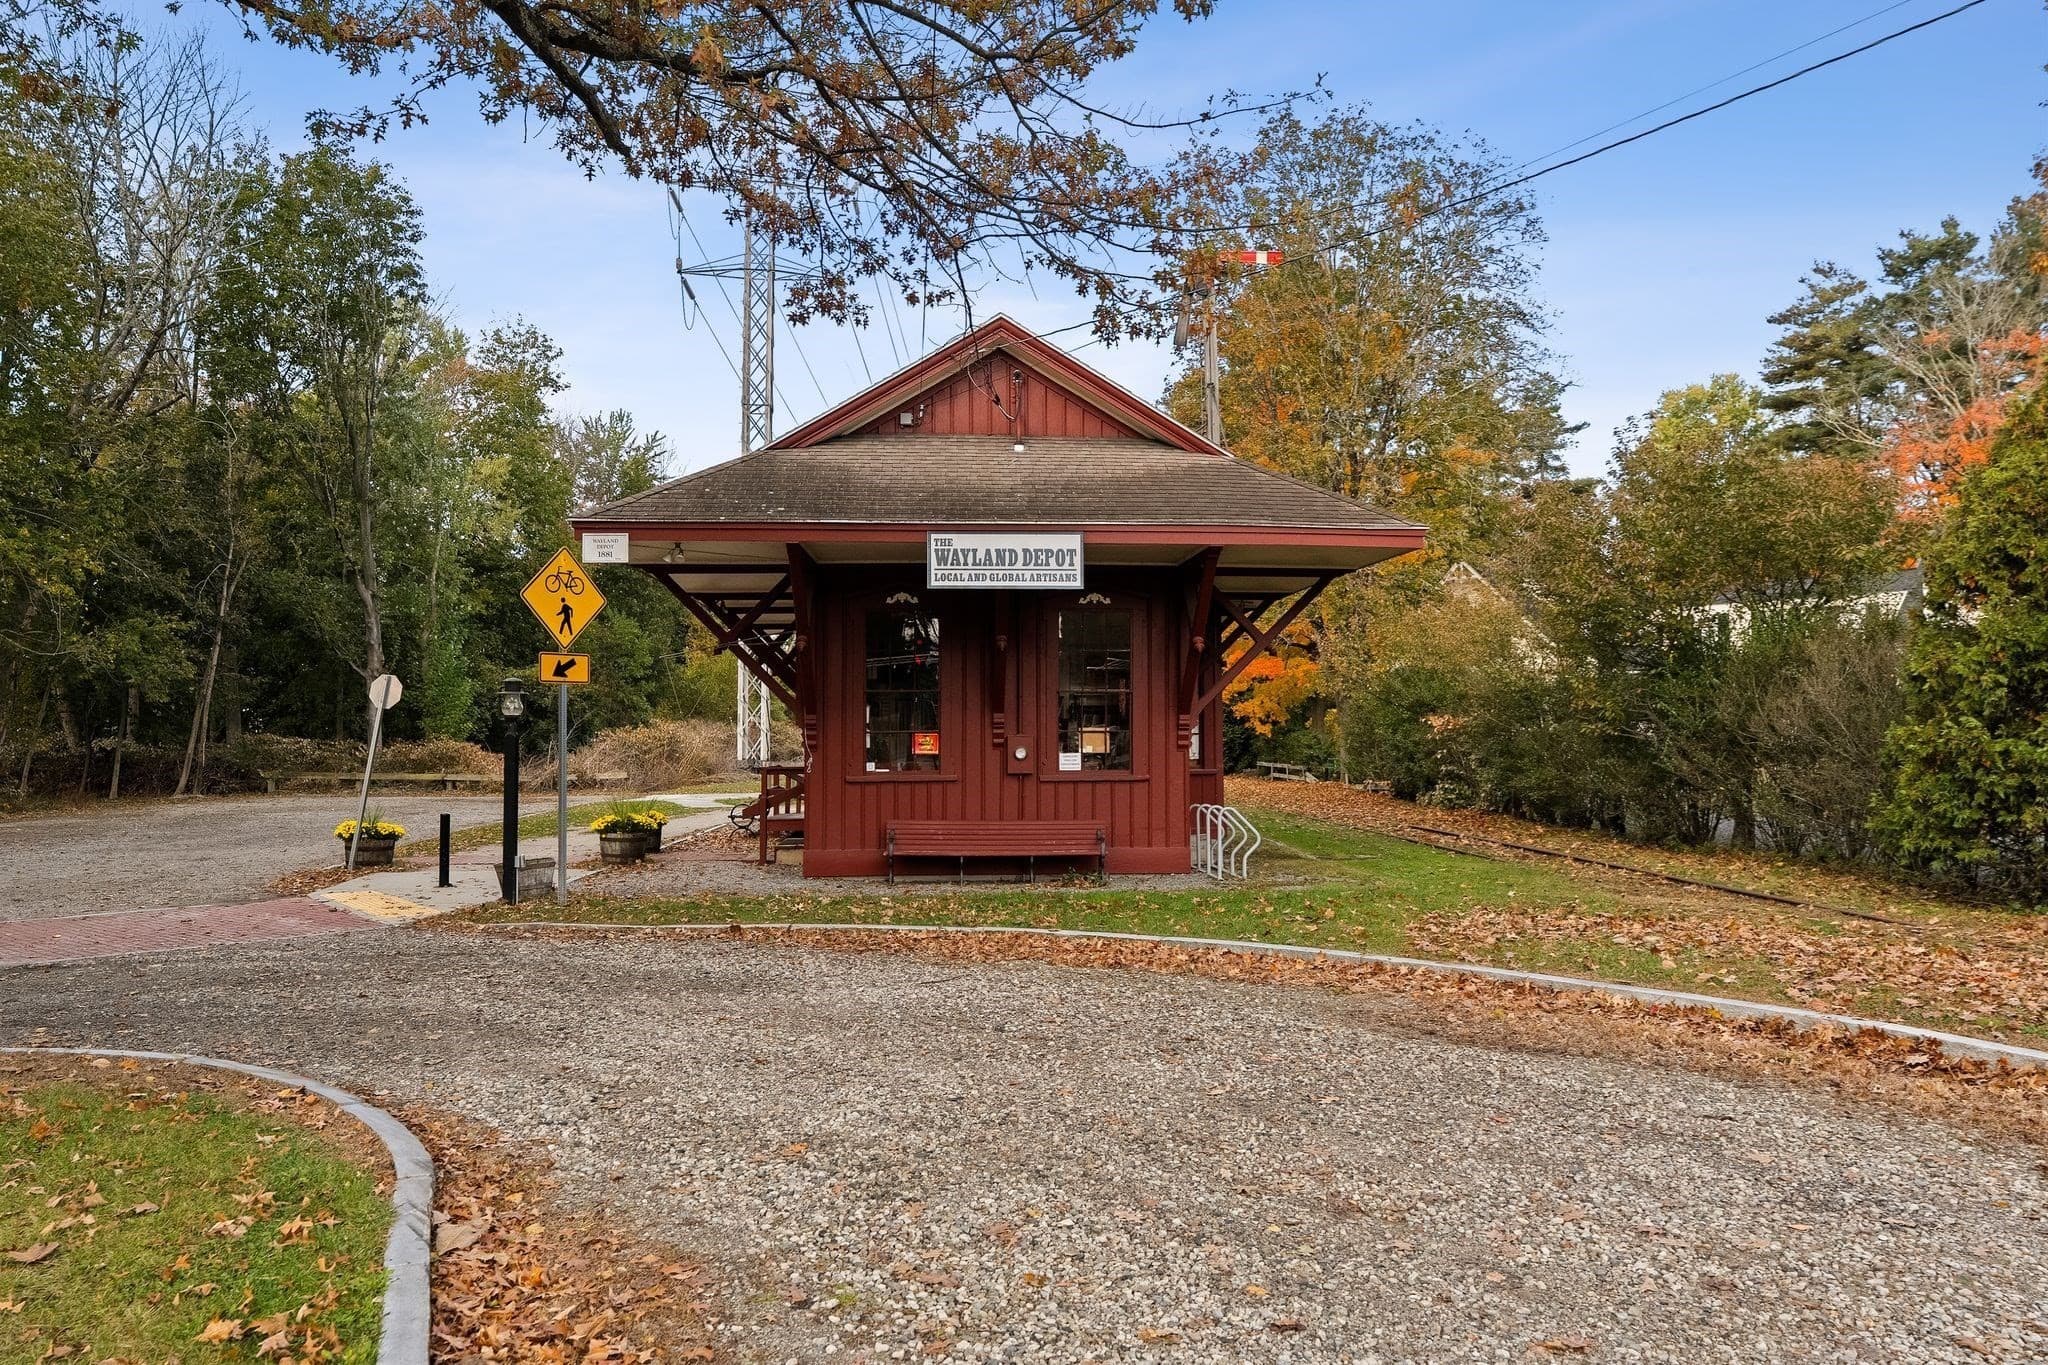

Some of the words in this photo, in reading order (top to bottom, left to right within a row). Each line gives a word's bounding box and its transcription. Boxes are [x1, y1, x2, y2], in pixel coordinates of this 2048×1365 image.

[934, 538, 953, 547] THE
[934, 548, 1018, 567] WAYLAND
[1022, 548, 1077, 567] DEPOT
[934, 573, 965, 582] LOCAL
[967, 573, 987, 582] AND
[989, 573, 1027, 582] GLOBAL
[1029, 573, 1077, 582] ARTISANS
